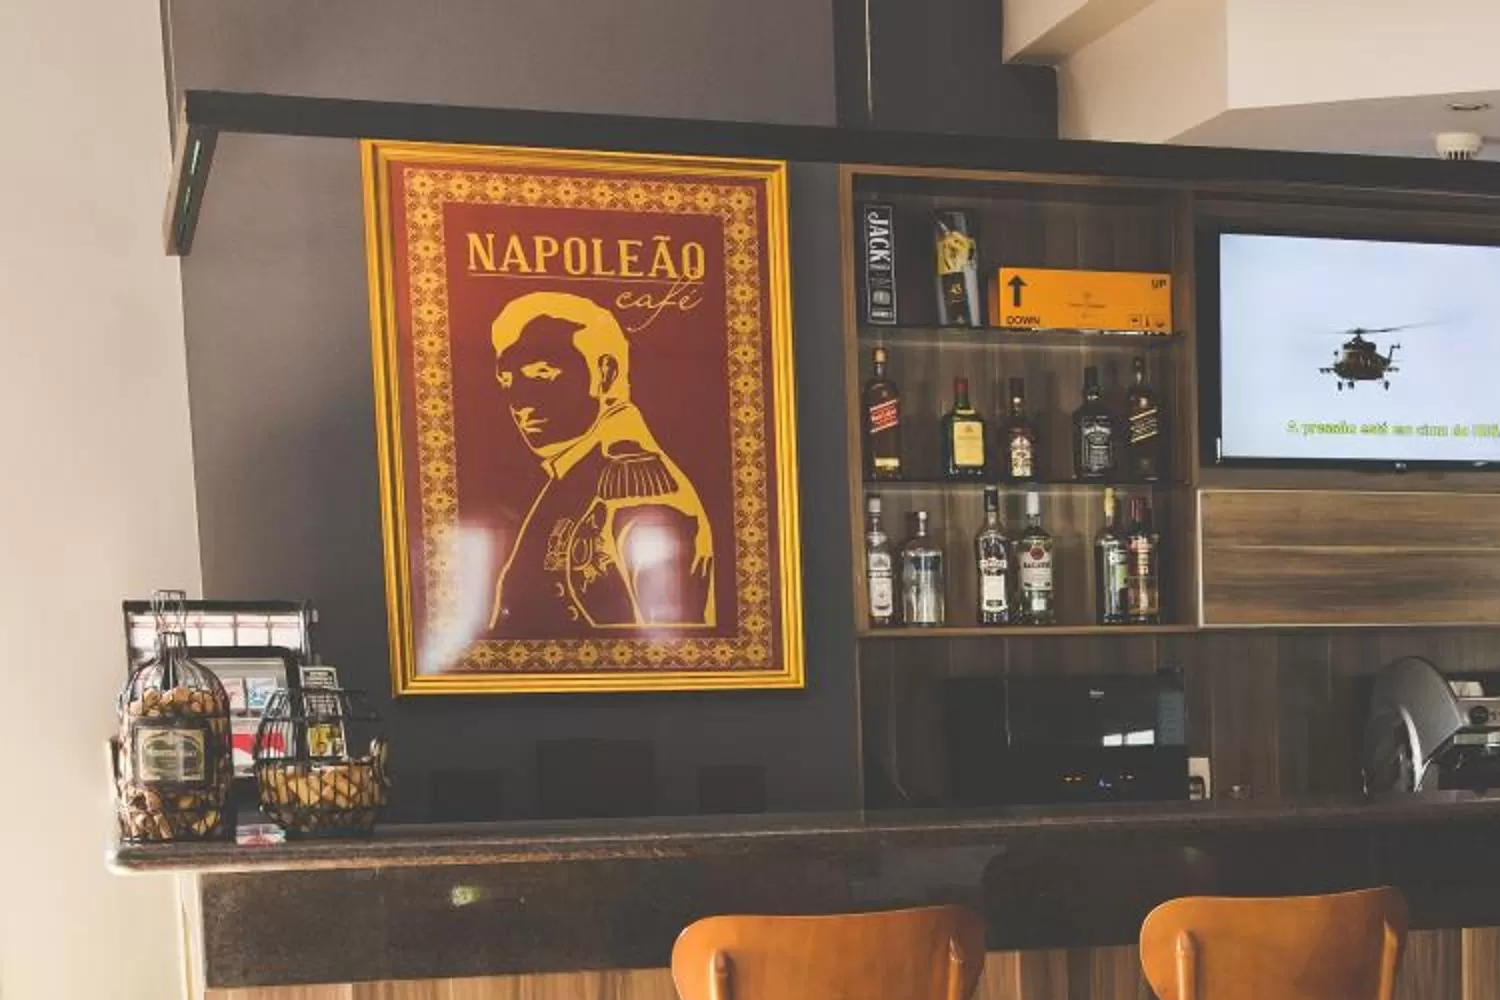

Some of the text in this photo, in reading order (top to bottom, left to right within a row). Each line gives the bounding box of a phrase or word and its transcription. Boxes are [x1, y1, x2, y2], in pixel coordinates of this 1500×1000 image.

[467, 232, 705, 280] NAPOLEÃO
[867, 211, 891, 263] JACK
[615, 273, 704, 332] café
[1151, 279, 1168, 289] UP
[1006, 315, 1041, 325] DOWN
